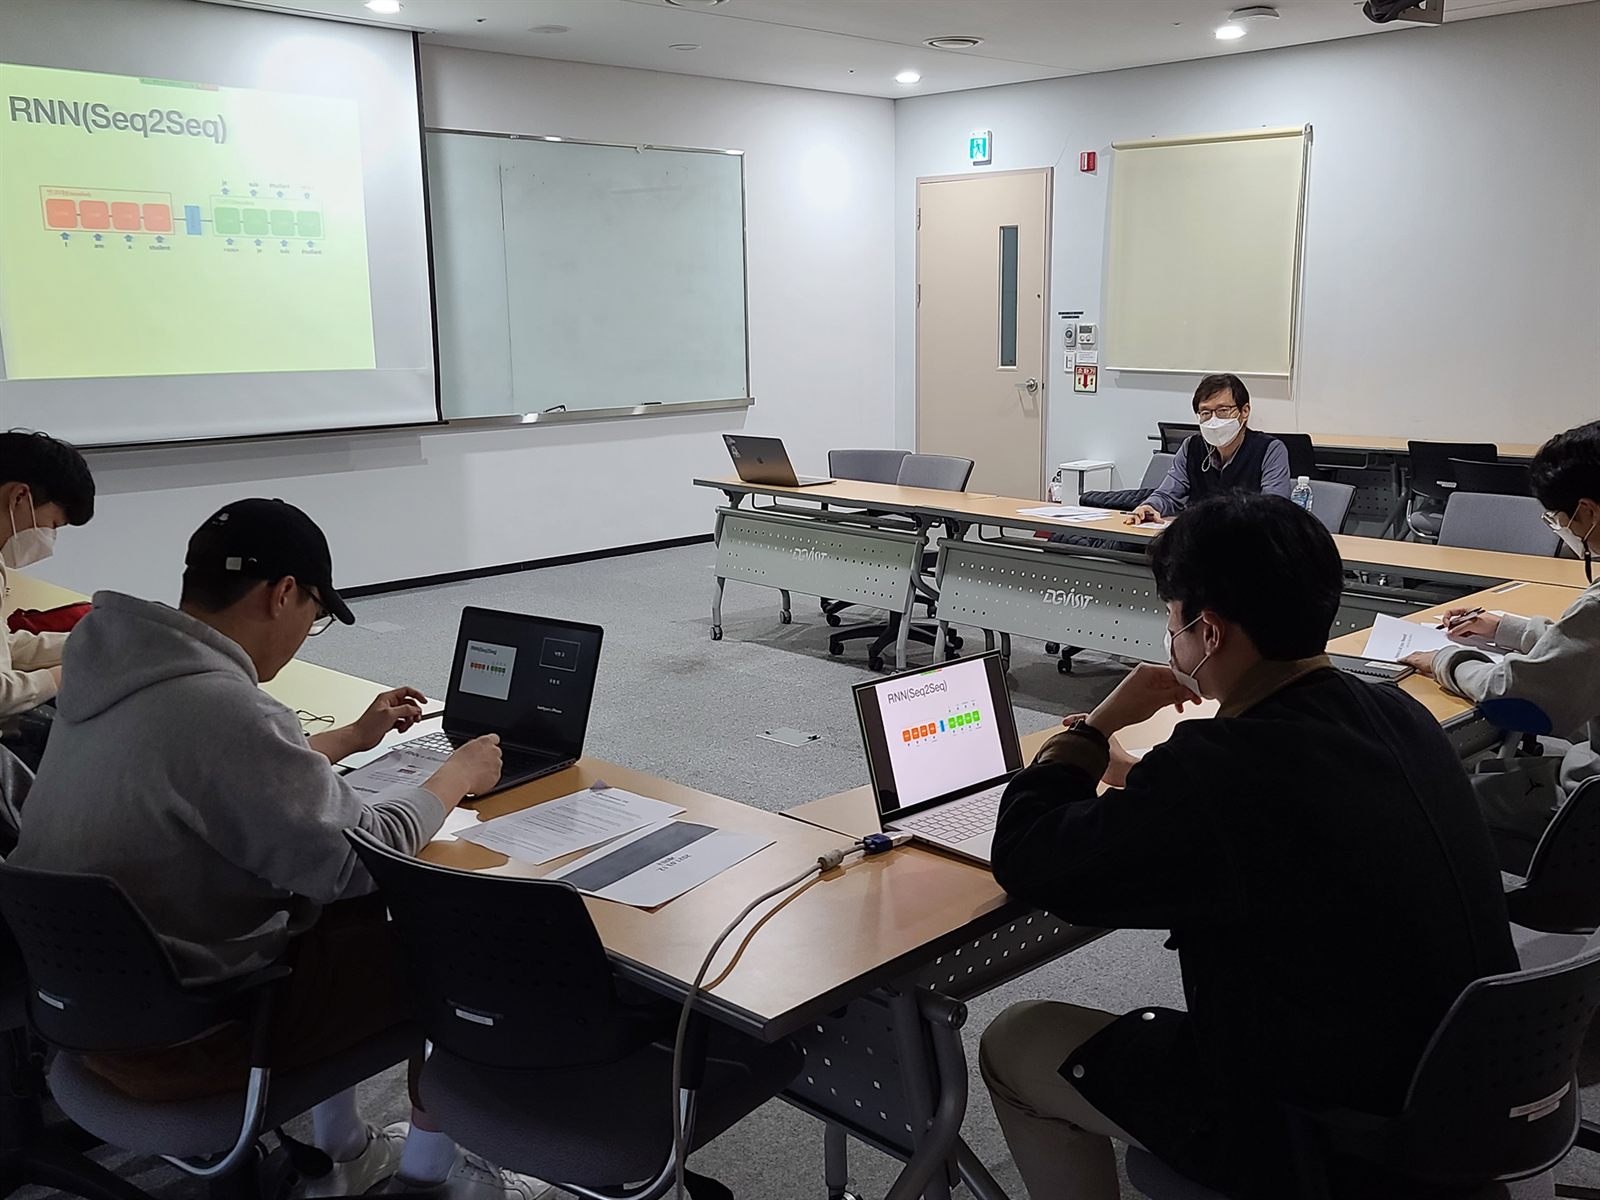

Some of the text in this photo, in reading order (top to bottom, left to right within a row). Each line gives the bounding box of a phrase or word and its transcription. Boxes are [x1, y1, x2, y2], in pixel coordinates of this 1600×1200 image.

[9, 95, 228, 144] RNN(Seq2Seq)
[1043, 588, 1094, 610] DGIST
[887, 680, 948, 704] RNN(Seq2Seq)
